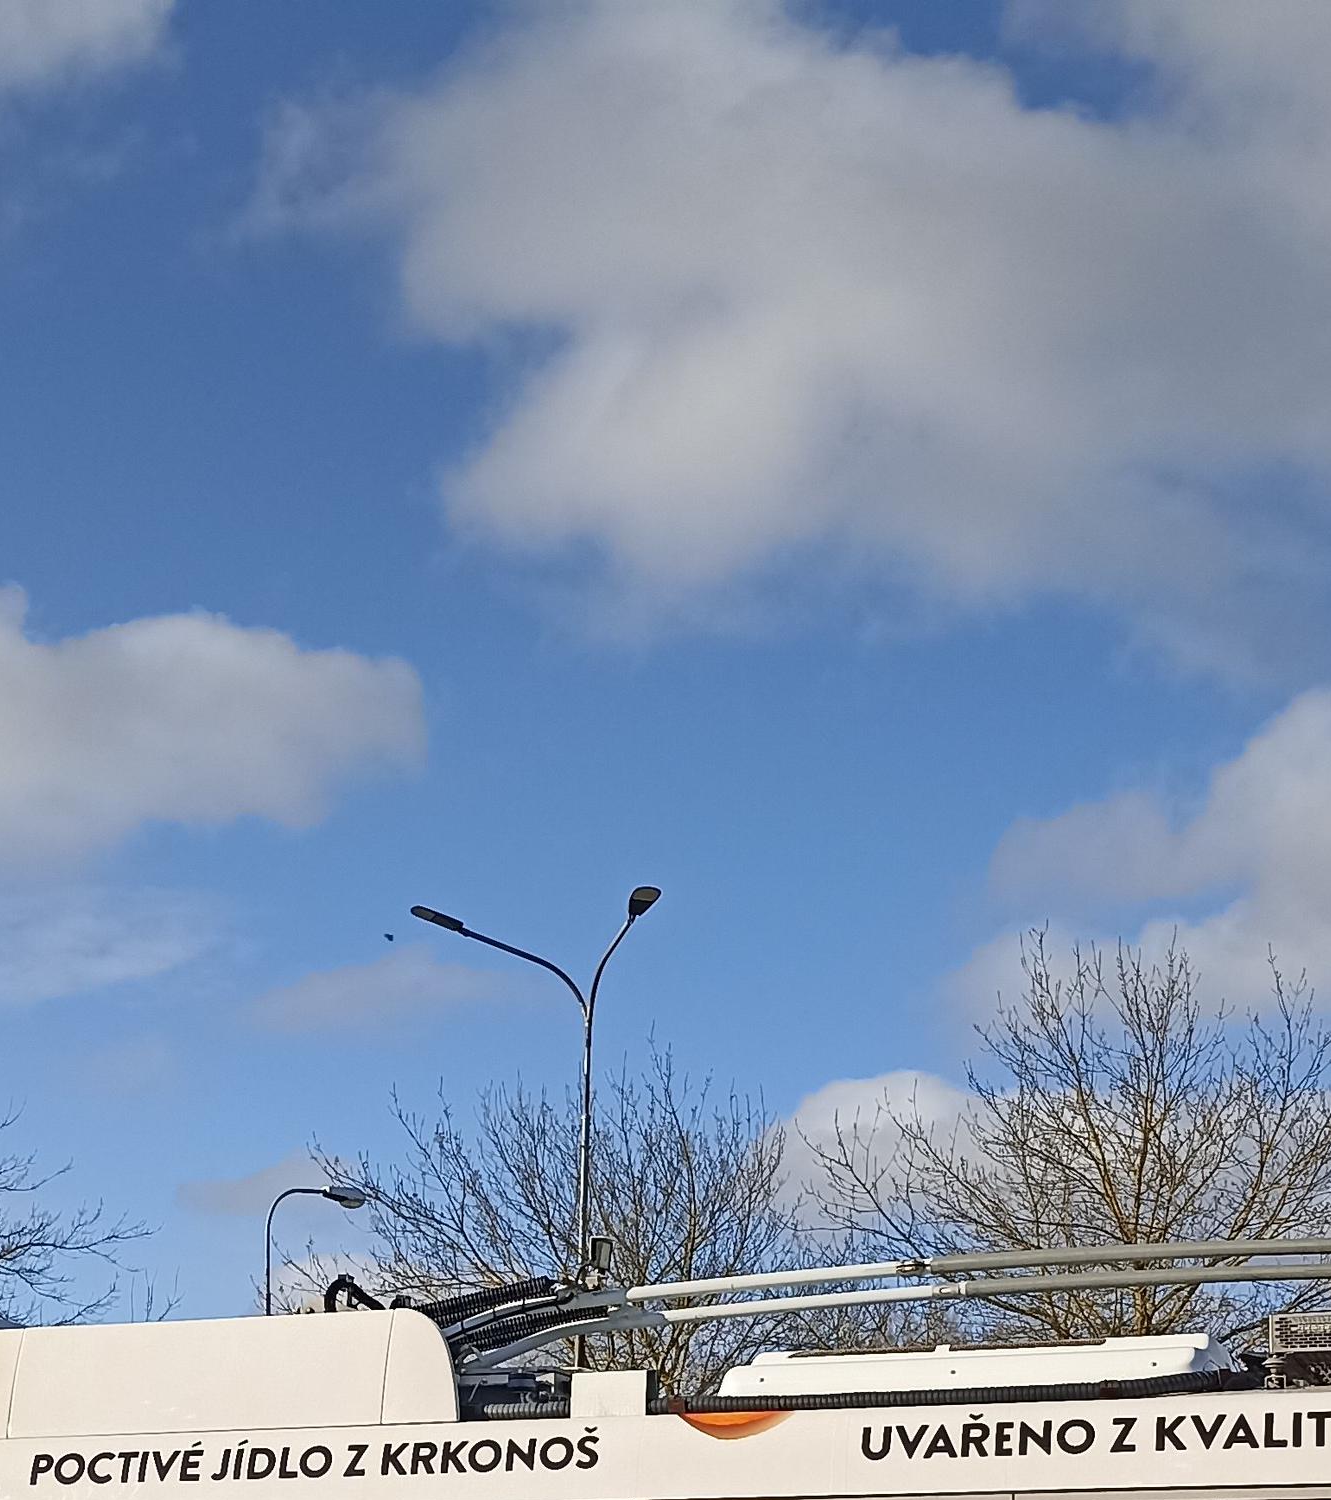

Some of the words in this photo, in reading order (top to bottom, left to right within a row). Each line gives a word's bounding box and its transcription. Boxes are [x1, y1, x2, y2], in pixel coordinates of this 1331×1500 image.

[29, 1440, 205, 1485] POCTIVÉ
[210, 1439, 333, 1481] JÍDLO
[343, 1444, 369, 1477] Z
[381, 1426, 600, 1476] KRKONOŠ
[861, 1413, 1096, 1460] UVAŘENO
[1109, 1417, 1138, 1453] Z
